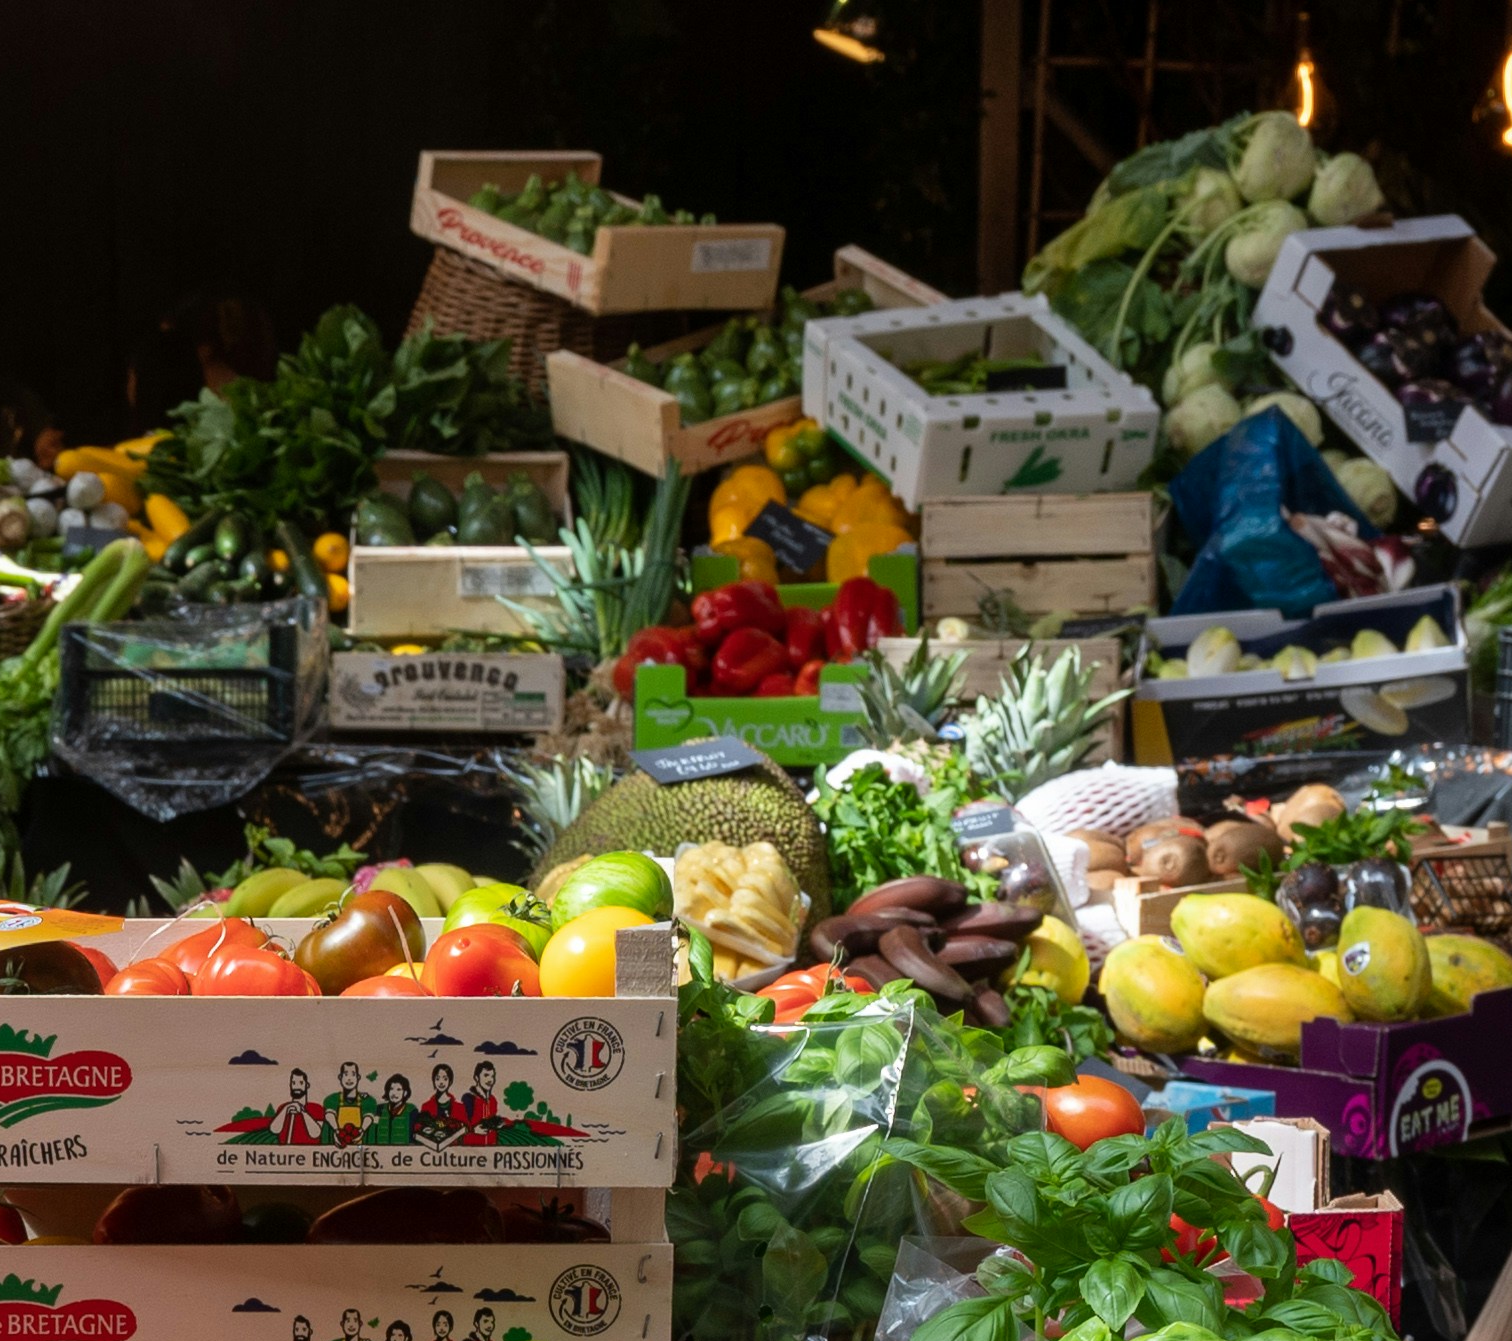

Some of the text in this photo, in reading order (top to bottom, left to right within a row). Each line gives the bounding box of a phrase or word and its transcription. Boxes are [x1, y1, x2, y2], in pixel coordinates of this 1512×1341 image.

[436, 207, 545, 273] Provence
[990, 430, 1043, 443] FRESH
[583, 1021, 595, 1030] EN
[597, 1023, 621, 1054] FRANCE
[0, 1064, 124, 1088] BRETAGNE
[1400, 1094, 1461, 1143] EAT ME
[216, 1150, 237, 1167] de
[244, 1150, 306, 1168] Nature
[391, 1150, 413, 1167] de
[419, 1151, 487, 1168] Culture
[6, 1313, 128, 1338] BRETAGNE
